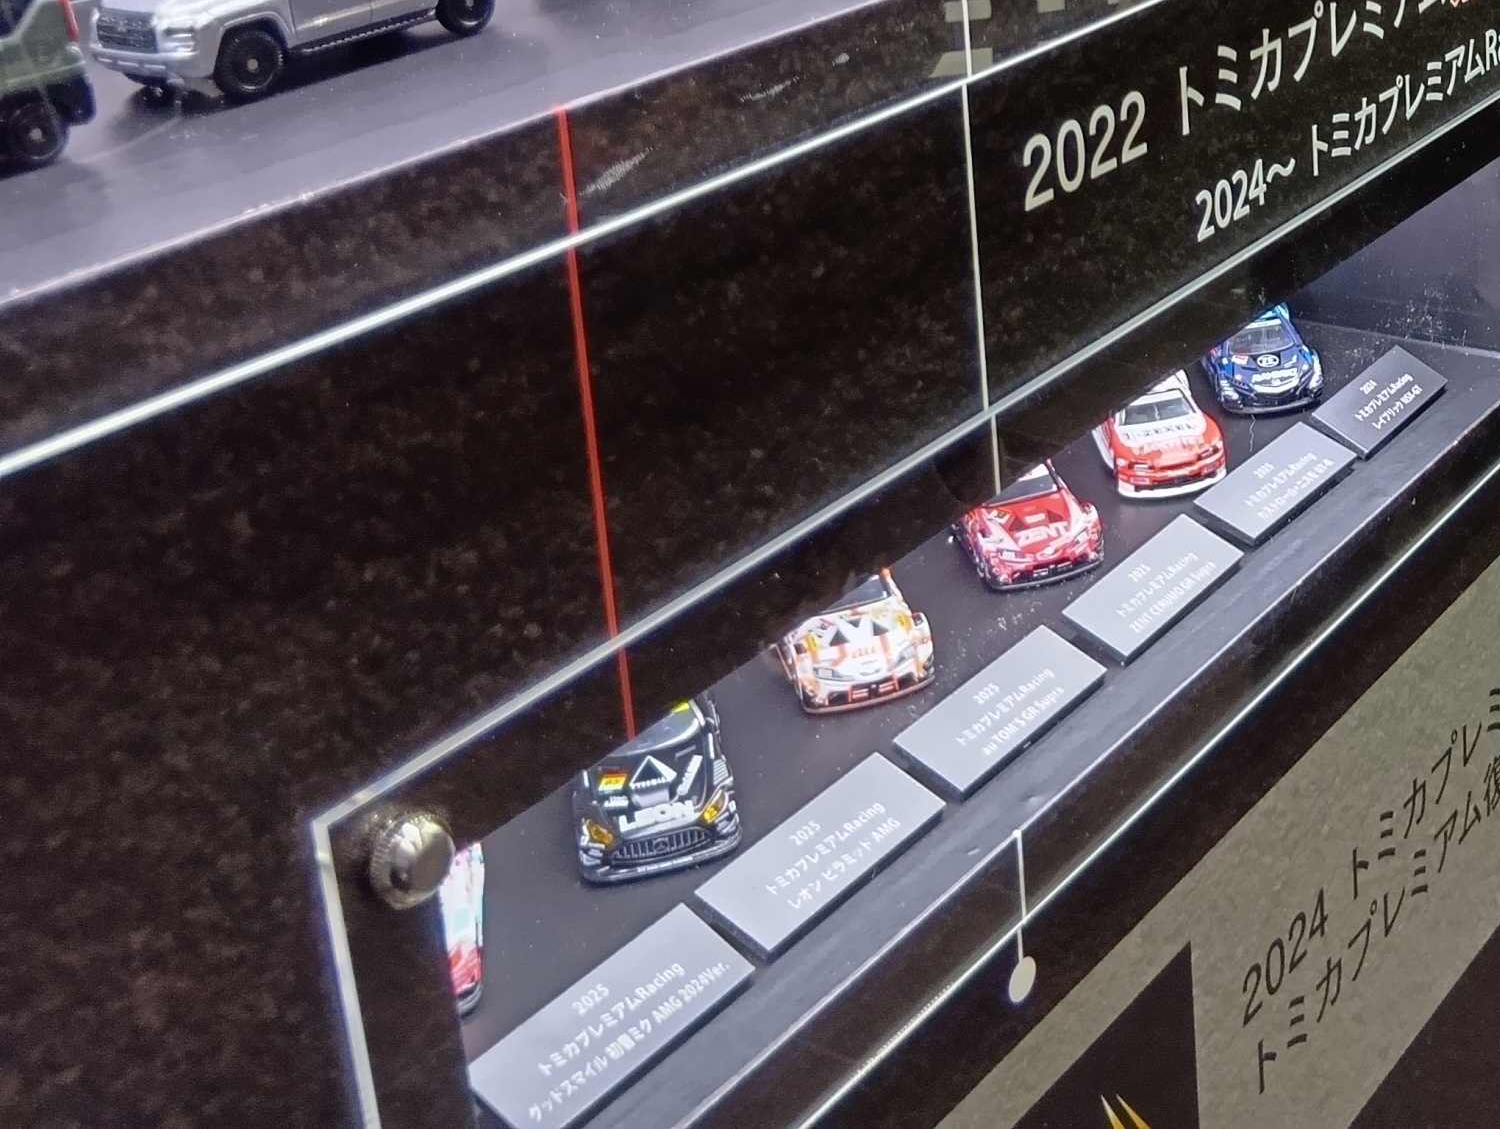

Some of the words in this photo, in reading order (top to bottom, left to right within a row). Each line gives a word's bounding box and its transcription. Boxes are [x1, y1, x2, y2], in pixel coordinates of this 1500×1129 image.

[1023, 90, 1149, 212] 2022
[1015, 520, 1068, 548] ZENT
[1115, 552, 1200, 618] トミカプレミアムRacing
[1126, 563, 1152, 583] 2025
[1180, 577, 1197, 591] GR
[1189, 560, 1218, 582] Supra
[955, 668, 1056, 746] トミカプレミアムRacing
[972, 682, 1000, 705] 2025
[991, 716, 1026, 744] TOM'S
[1021, 705, 1041, 722] GR
[1033, 686, 1066, 711] Supra
[618, 799, 695, 834] LEON
[788, 819, 822, 846] 2025
[765, 801, 886, 896] トミカプレミアムRacing
[787, 879, 822, 910] レオン
[821, 837, 873, 881] ピラミッド
[870, 816, 902, 843] AMG
[1242, 887, 1330, 1028] 2024
[538, 962, 686, 1077] トミカプレミアムRacing
[571, 982, 611, 1017] 2025
[652, 995, 683, 1024] AMG
[676, 961, 731, 1003] 2024Ver.
